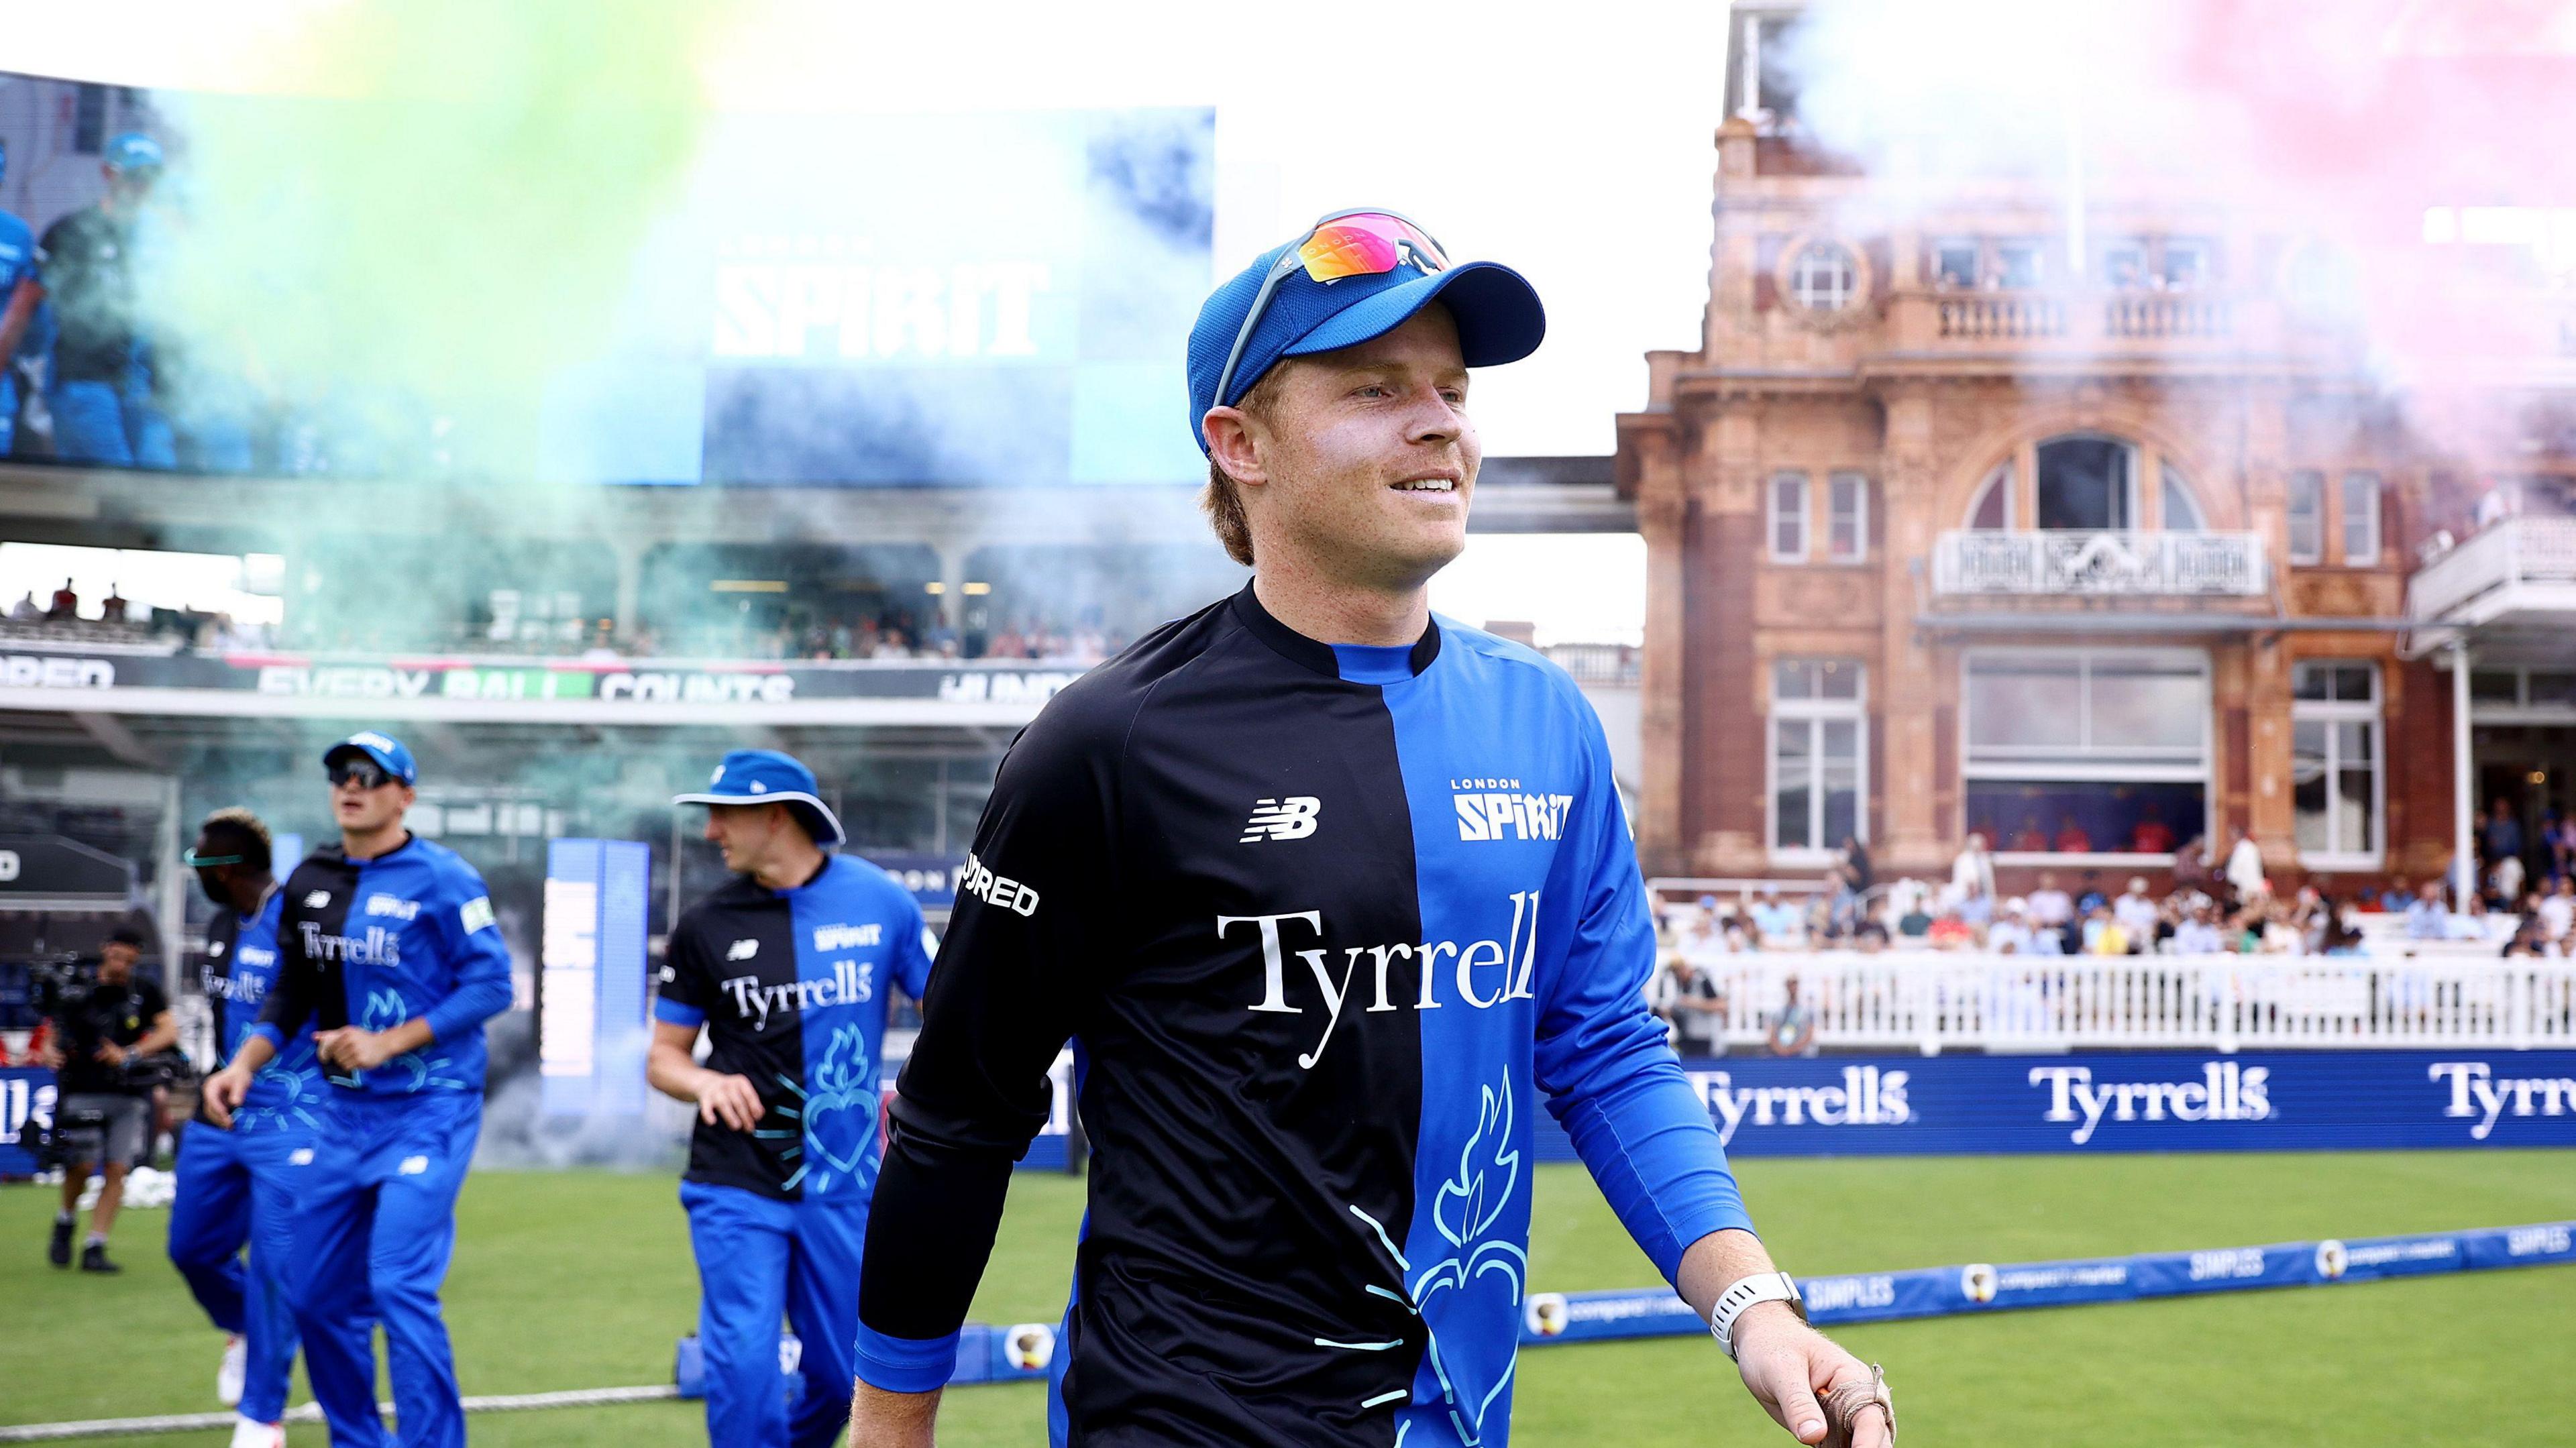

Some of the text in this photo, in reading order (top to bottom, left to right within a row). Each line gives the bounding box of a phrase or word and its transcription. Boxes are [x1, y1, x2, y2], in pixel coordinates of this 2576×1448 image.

[1450, 778, 1521, 789] LONDON
[1218, 891, 1540, 1069] Tyrrell
[2428, 1062, 2576, 1141] Tyrr
[1805, 1276, 1895, 1312] SIMPLES
